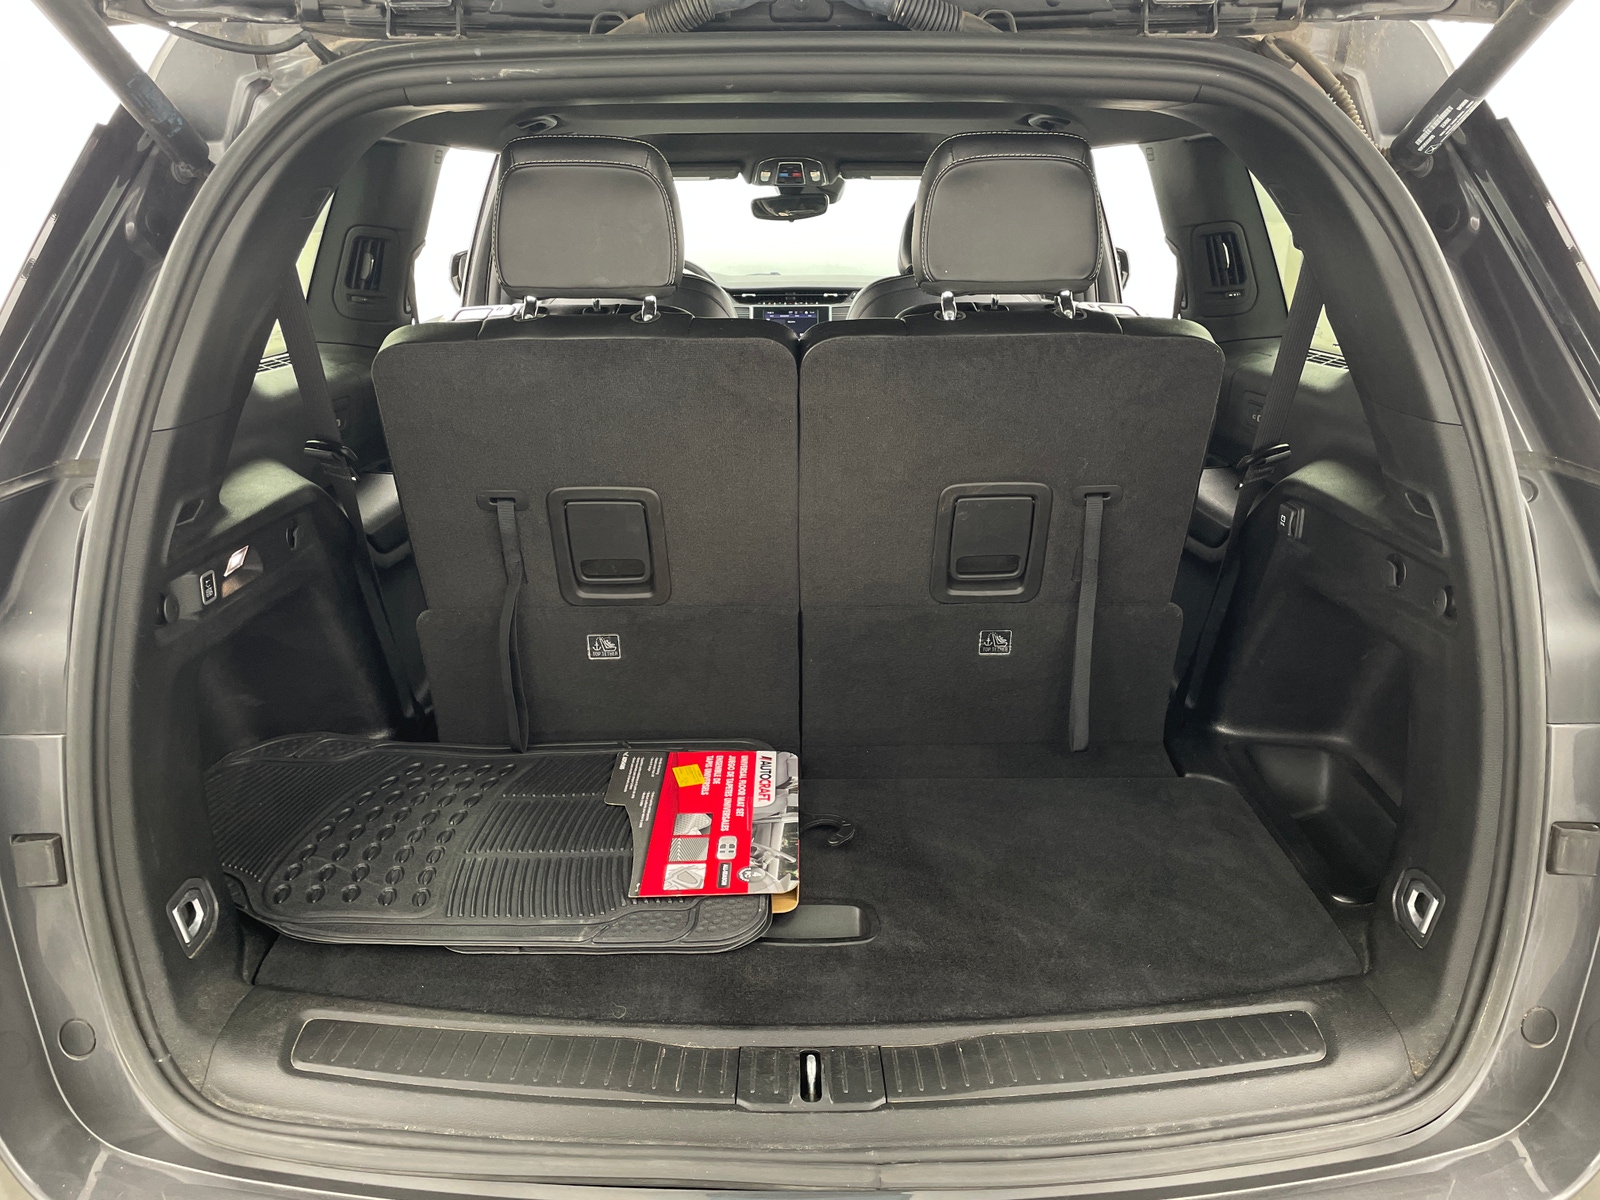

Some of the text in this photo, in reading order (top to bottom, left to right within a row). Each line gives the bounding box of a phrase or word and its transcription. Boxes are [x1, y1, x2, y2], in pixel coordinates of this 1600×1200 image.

[700, 755, 714, 796] TAPIS UNIVERSELS
[714, 755, 724, 778] ENSEMBLE
[728, 755, 736, 770] JUEGO
[724, 778, 734, 797] TAPETES
[736, 755, 748, 818] UNIVERSAL FLOOR MAT SET
[758, 760, 772, 802] AUTOCRAFT
[720, 798, 732, 832] UNIVERSALES
